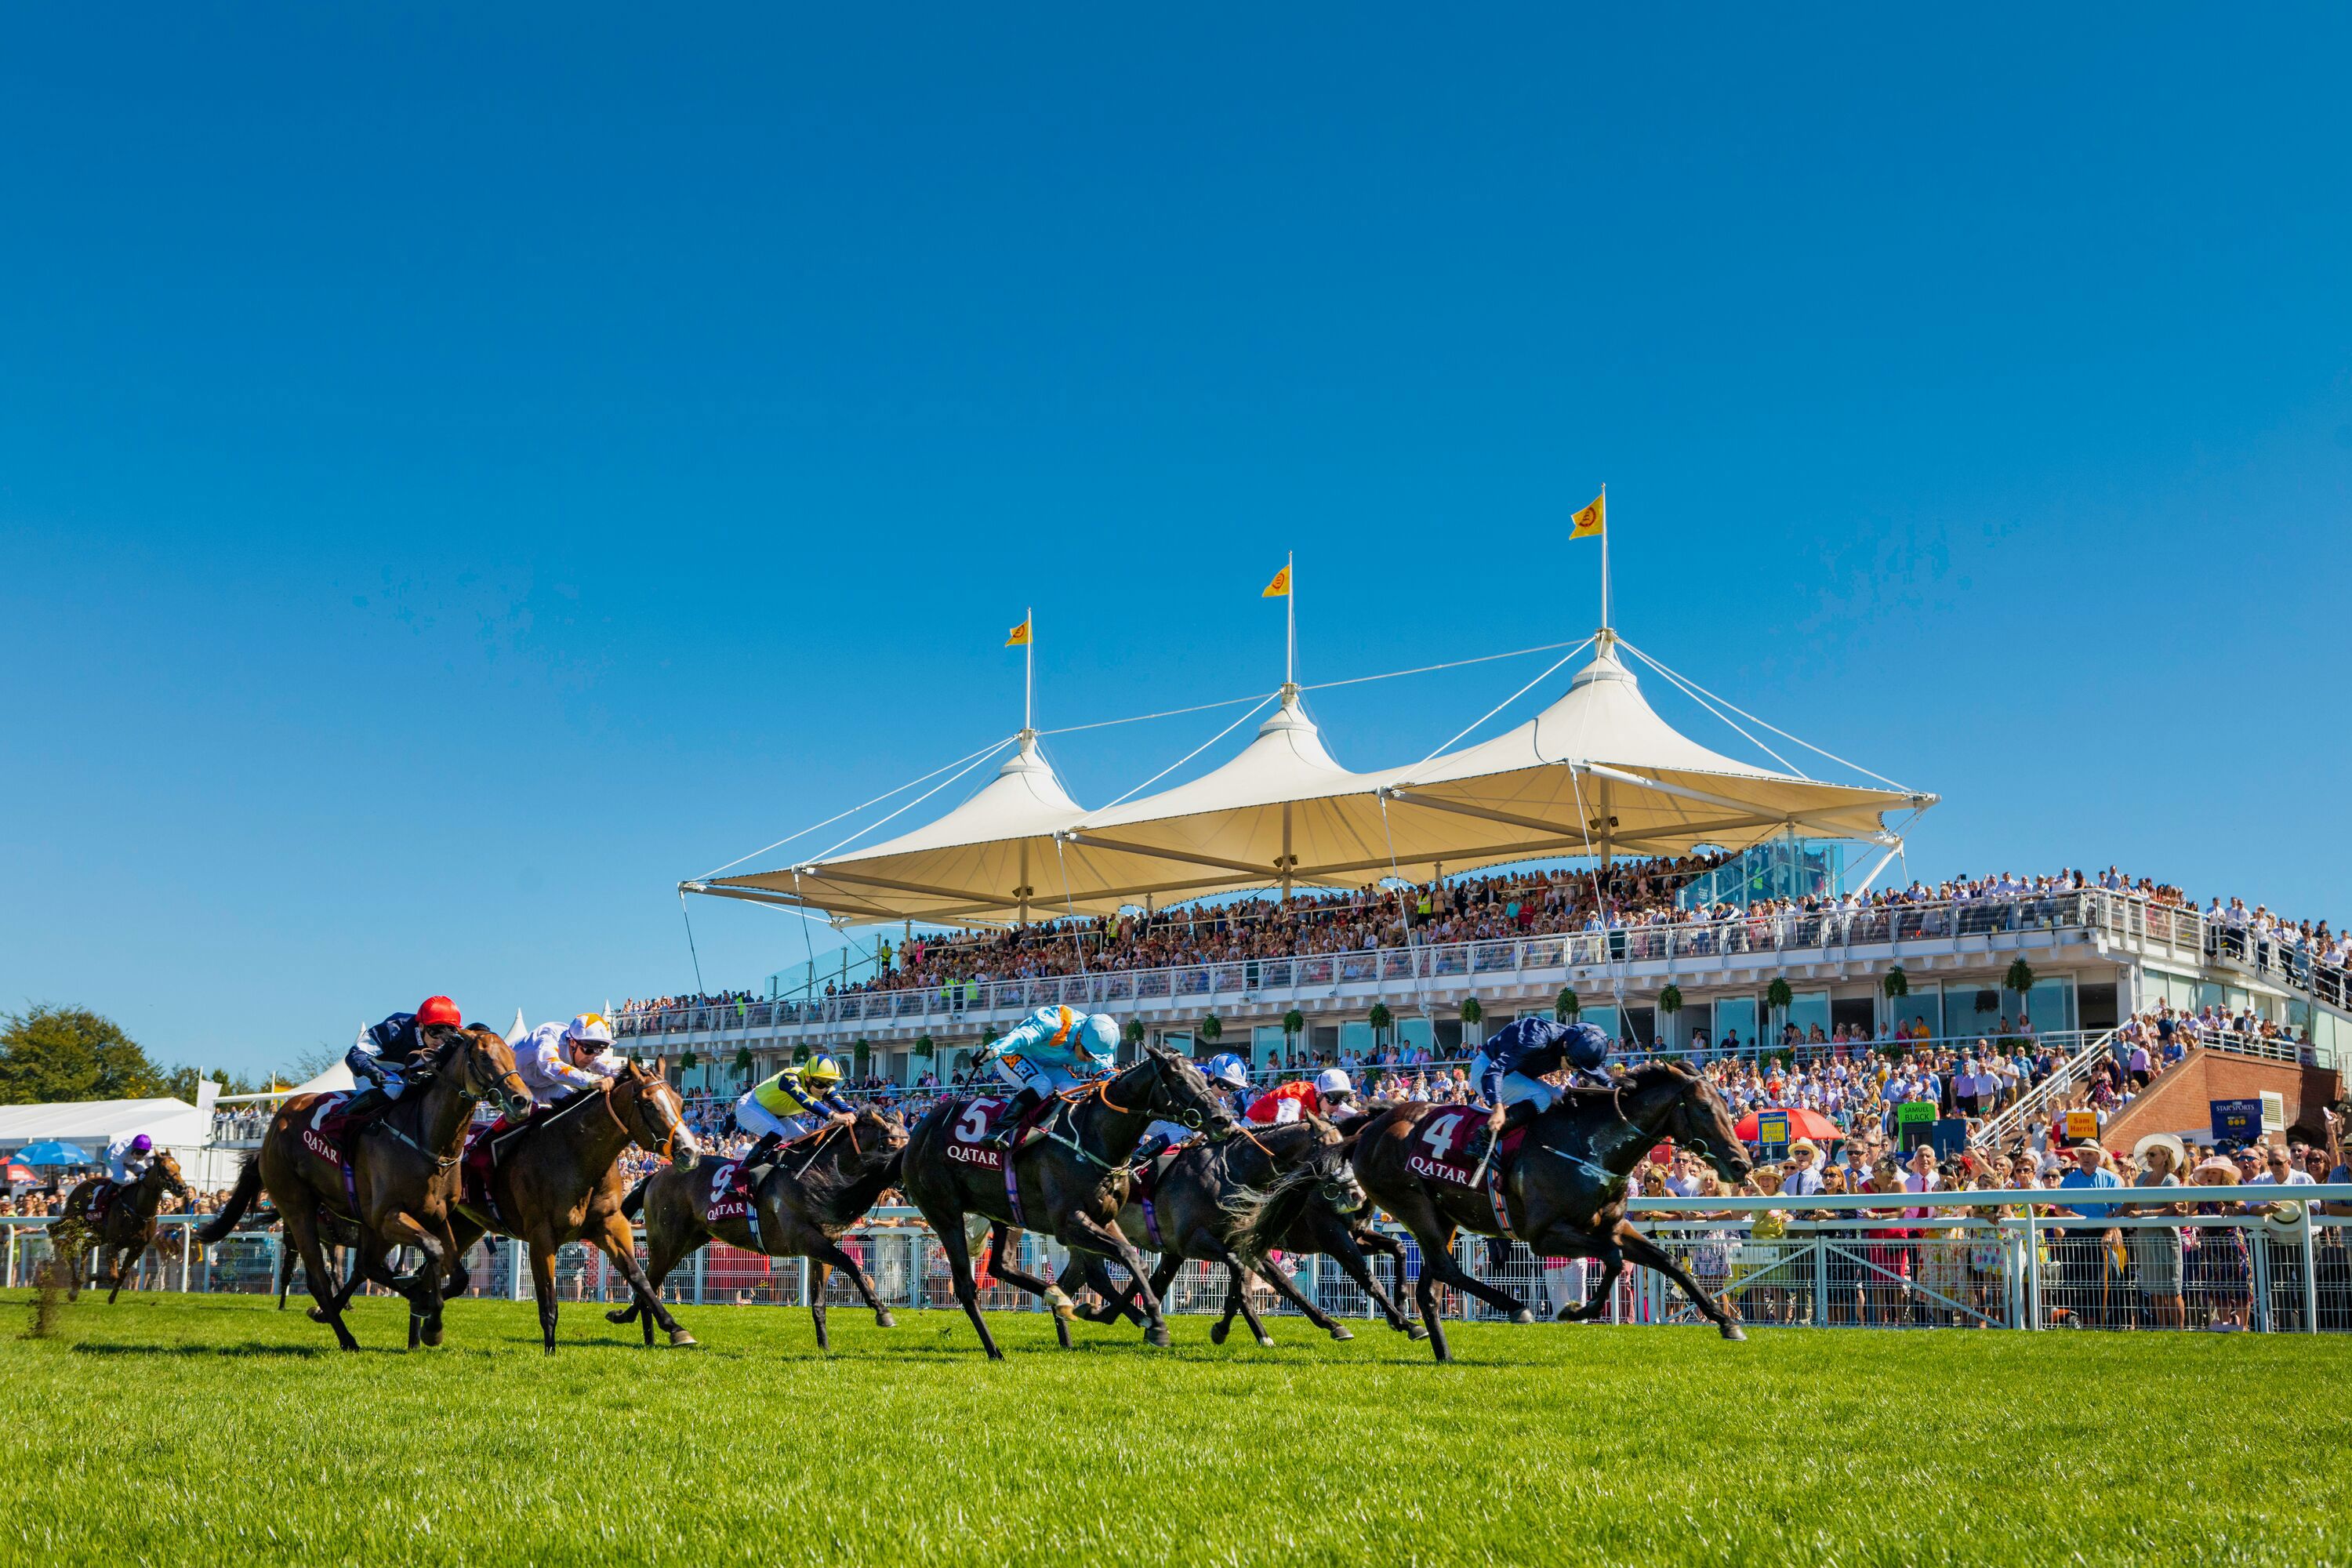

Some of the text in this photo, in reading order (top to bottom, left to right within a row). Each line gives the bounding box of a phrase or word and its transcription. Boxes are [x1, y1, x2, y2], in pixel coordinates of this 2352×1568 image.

[955, 1098, 1000, 1142] 5
[303, 1131, 337, 1163] QATAR
[1422, 1113, 1464, 1160] 4
[947, 1145, 999, 1166] QATAR
[1410, 1156, 1467, 1185] QATAR
[710, 1164, 735, 1203] 9
[707, 1203, 744, 1221] QATAR
